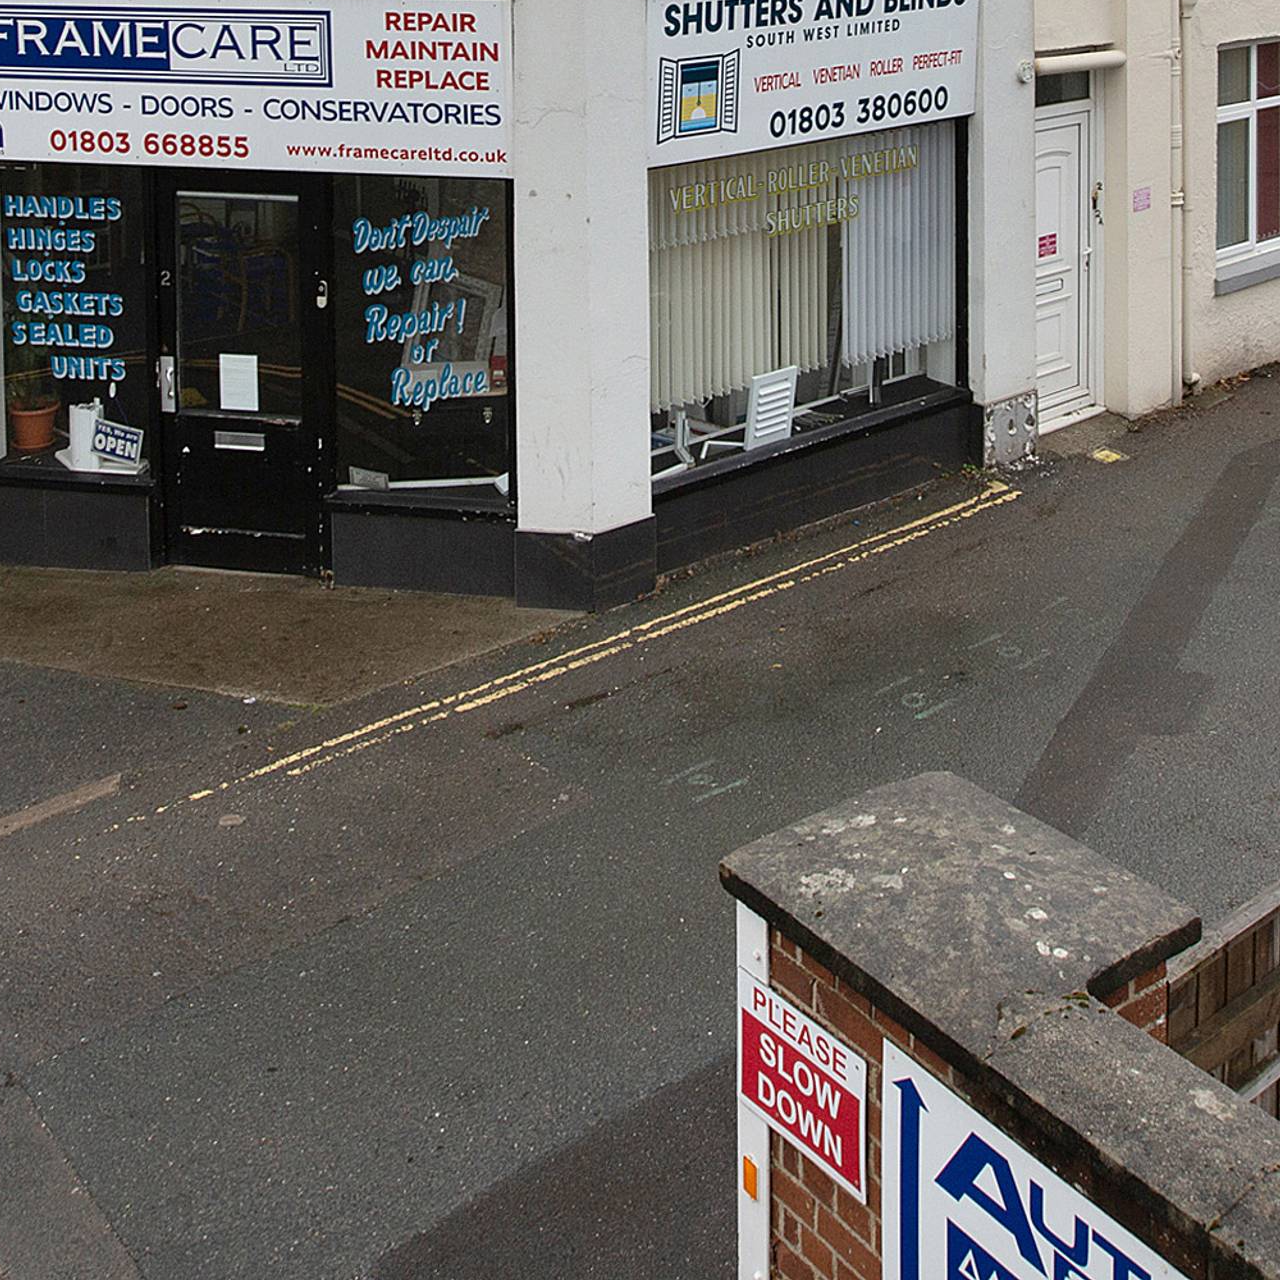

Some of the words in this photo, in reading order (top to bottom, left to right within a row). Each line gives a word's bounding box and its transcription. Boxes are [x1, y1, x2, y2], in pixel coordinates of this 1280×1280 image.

[384, 11, 477, 33] REPAIR
[746, 30, 795, 49] SOUTH
[802, 25, 840, 42] WEST
[847, 18, 901, 37] LIMITED
[366, 40, 500, 62] MAINTAIN
[283, 62, 320, 73] LTD
[376, 70, 491, 91] REPLACE
[753, 73, 801, 93] VERTICAL
[812, 64, 860, 85] VENETIAN
[870, 58, 904, 77] ROLLER
[912, 50, 963, 71] PERFECT-FIT
[141, 95, 234, 118] DOORS
[263, 98, 502, 126] CONSERVATORIES
[769, 101, 845, 138] 01803
[856, 85, 949, 124] 380600
[50, 130, 130, 153] 01803
[144, 133, 249, 158] 668855
[286, 144, 508, 164] www.framecareltd.co.uk
[670, 174, 759, 214] VERTICAL
[767, 160, 830, 195] ROLLER
[840, 144, 919, 182] VENETIAN
[4, 195, 122, 221] HANDLES
[765, 194, 860, 238] SHUTTERS
[6, 227, 96, 253] HINGES
[412, 208, 490, 250] Despair
[11, 259, 86, 284] LOCKS
[160, 270, 171, 286] 2
[362, 265, 402, 296] we
[410, 256, 460, 286] can
[16, 290, 123, 317] GASKETS
[11, 321, 114, 349] SEALED
[412, 338, 440, 364] or
[50, 355, 127, 382] UNITS
[390, 363, 490, 412] Replace
[94, 433, 138, 458] OPEN
[753, 986, 848, 1082] PLEASE
[759, 1032, 842, 1120] SLOW
[758, 1071, 843, 1168] DOWN
